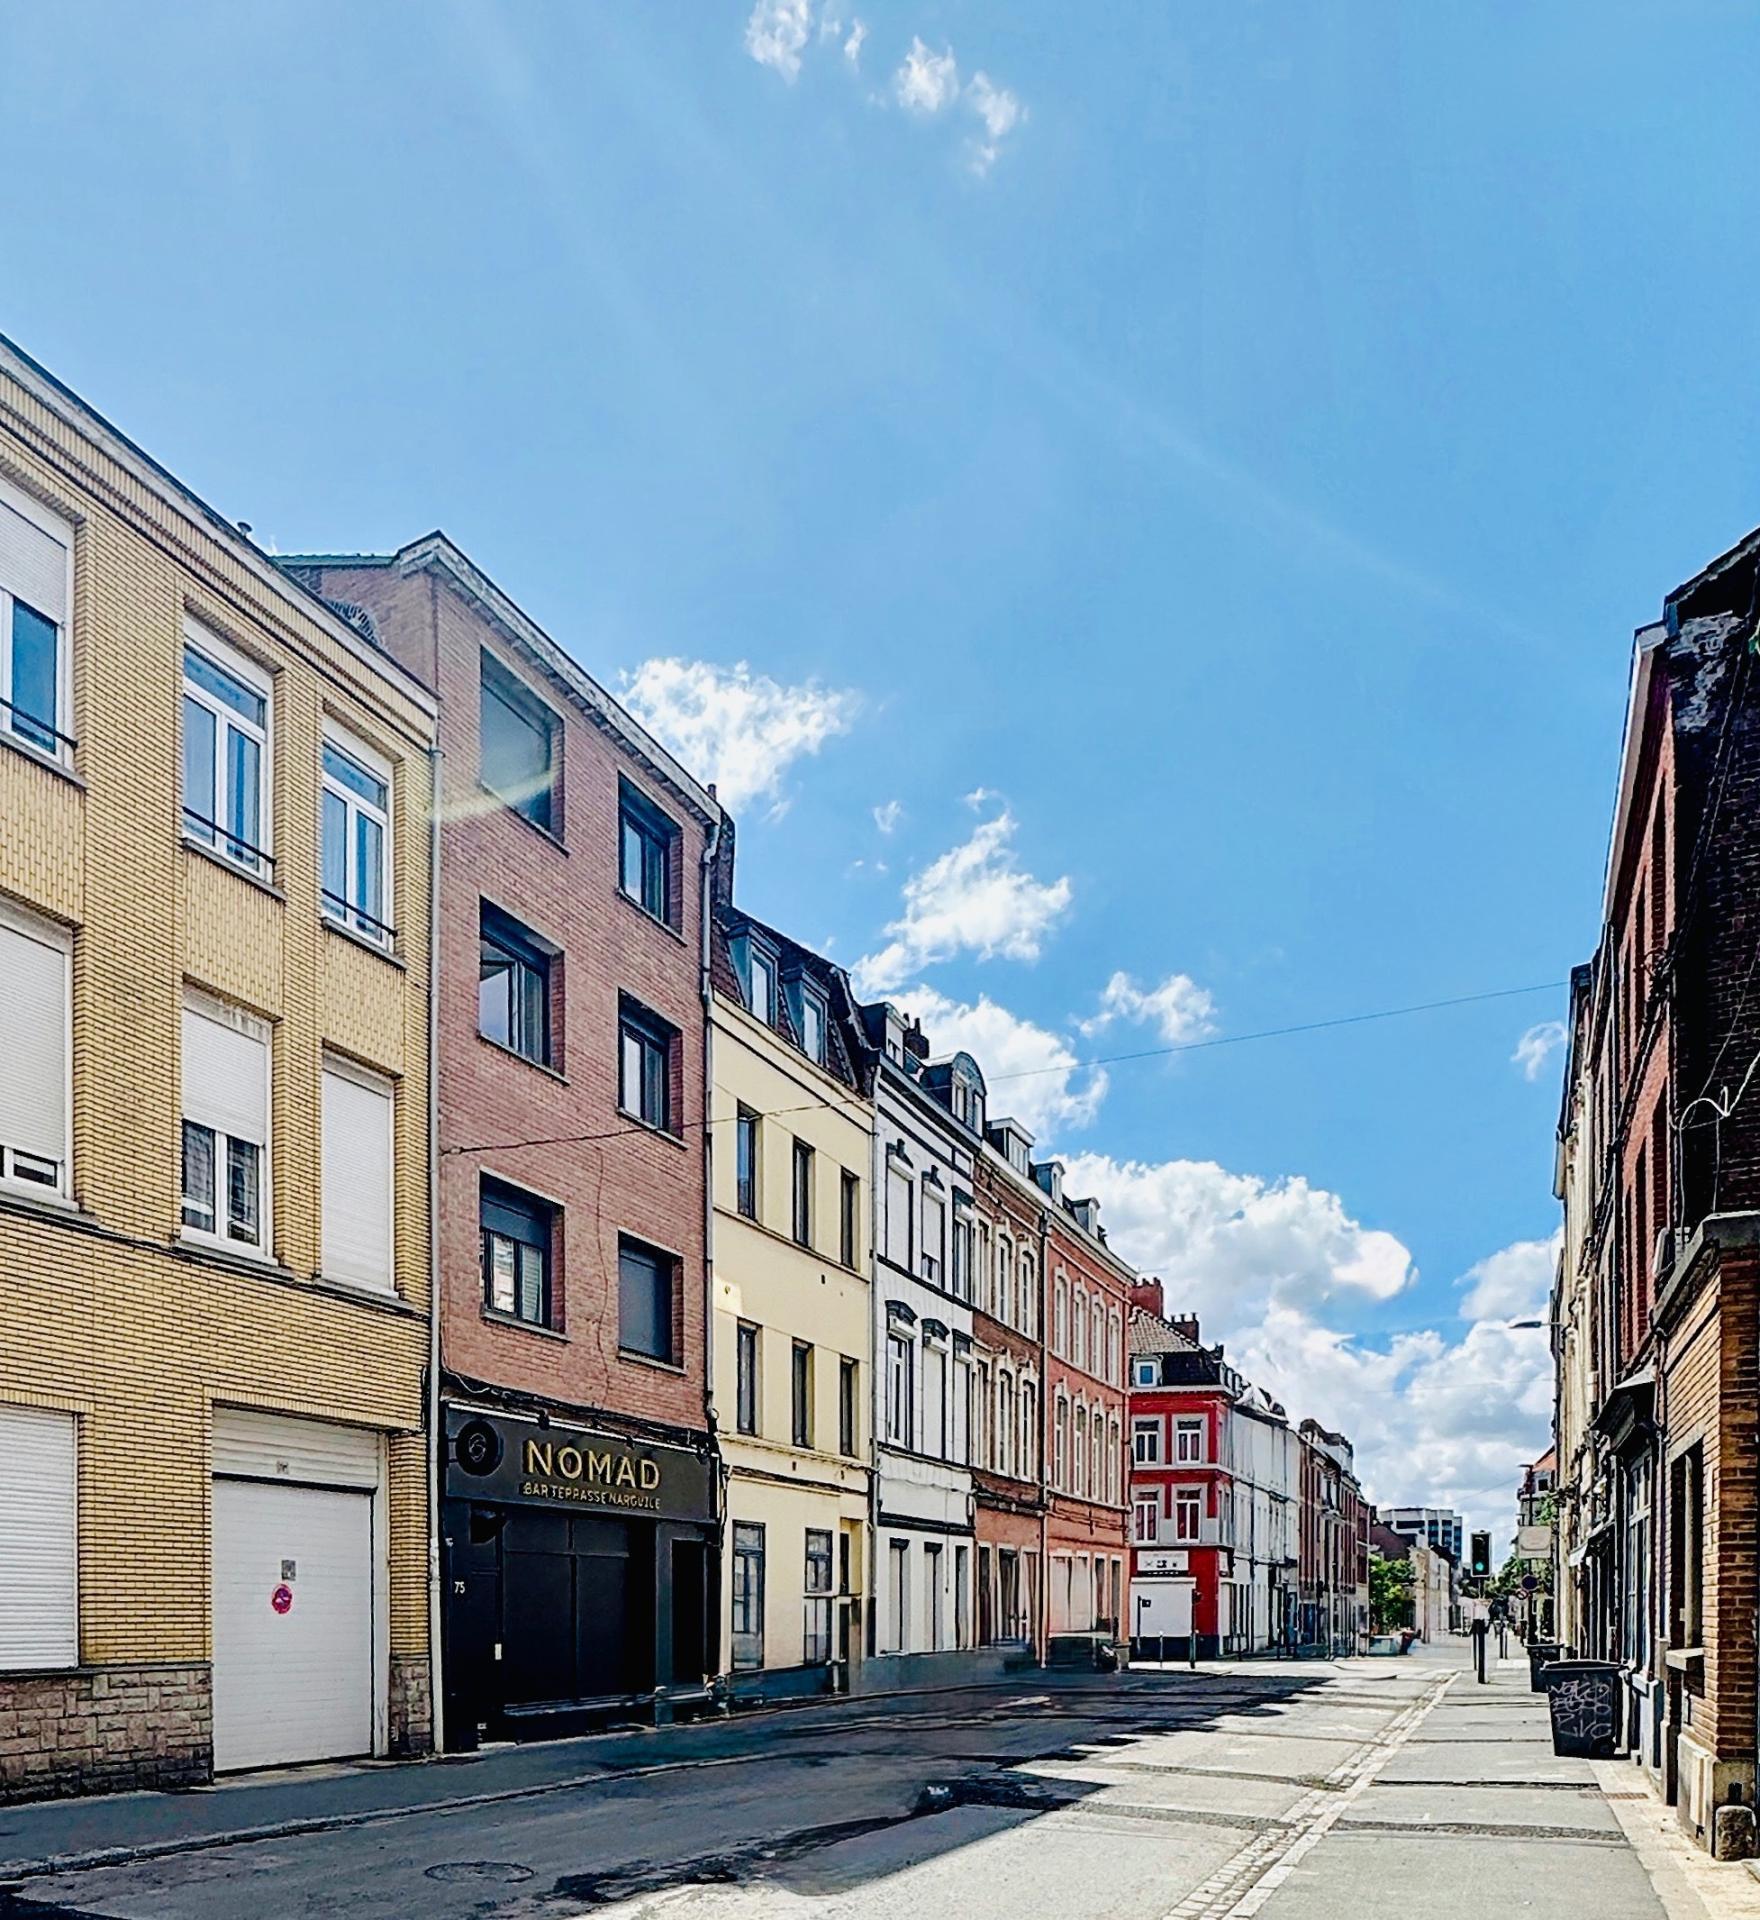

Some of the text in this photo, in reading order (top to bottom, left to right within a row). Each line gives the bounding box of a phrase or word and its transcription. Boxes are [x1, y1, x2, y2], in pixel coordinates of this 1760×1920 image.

[526, 1439, 660, 1490] NOMAD
[523, 1481, 549, 1498] BAR
[454, 1581, 466, 1594] 75
